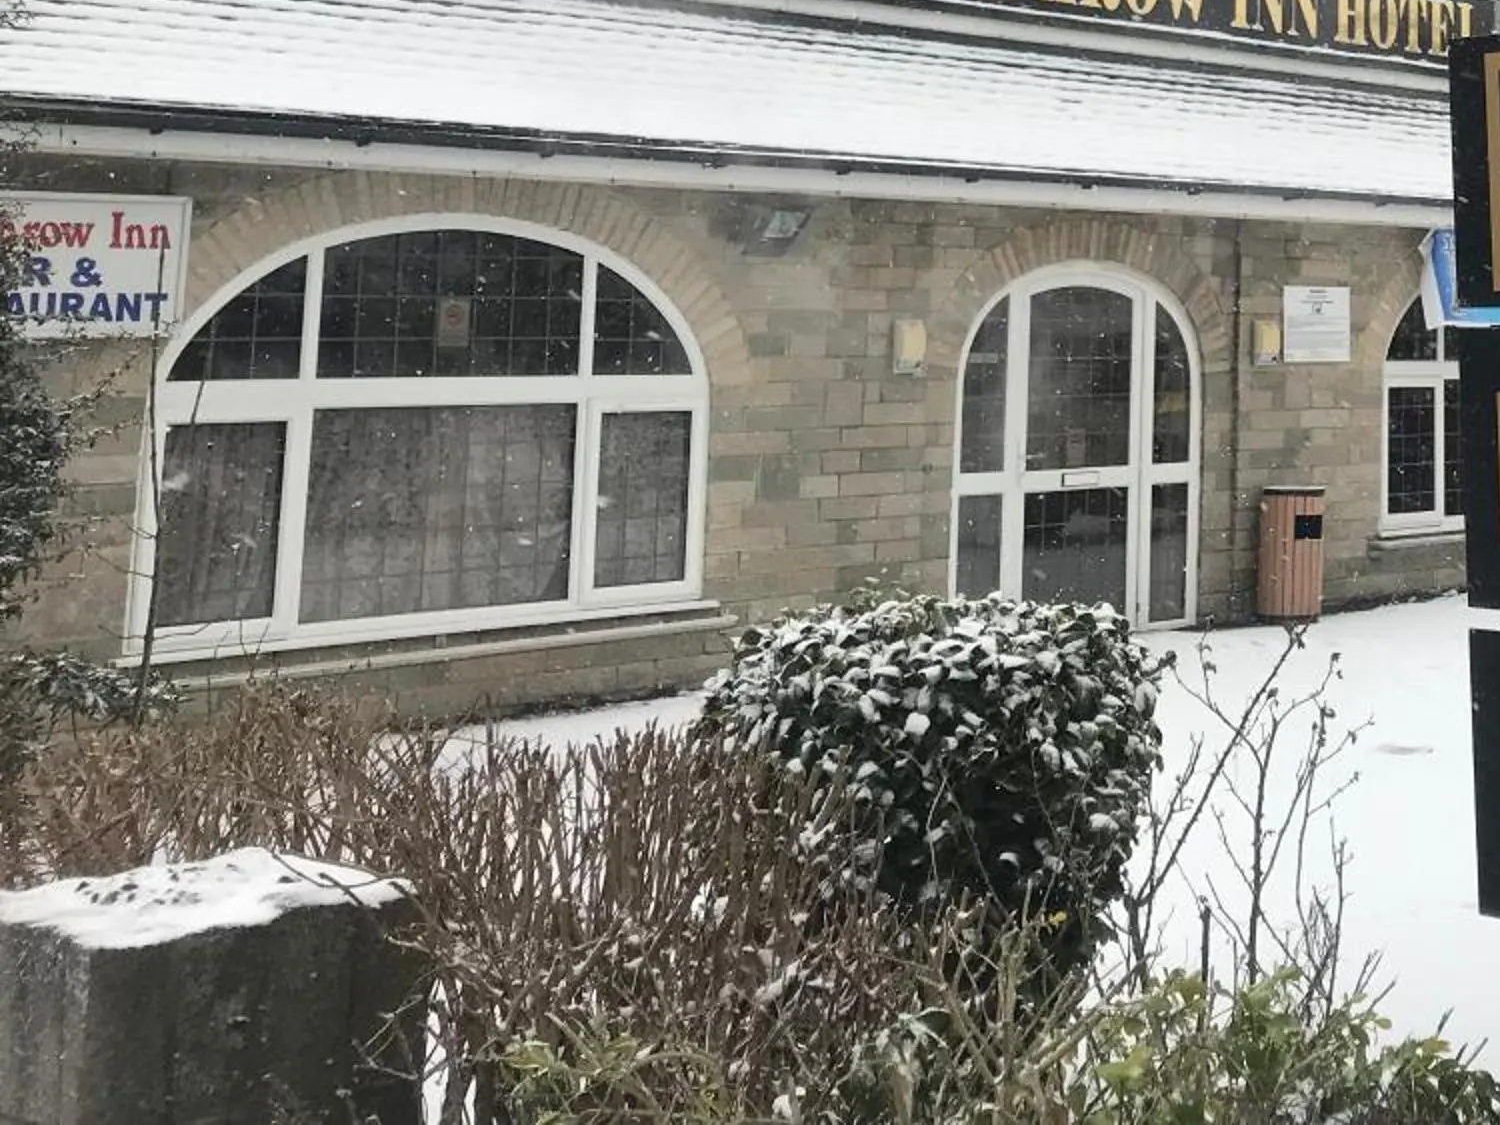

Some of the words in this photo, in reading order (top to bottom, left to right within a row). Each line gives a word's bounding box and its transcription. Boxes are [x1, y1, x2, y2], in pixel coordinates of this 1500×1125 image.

[109, 211, 171, 249] Inn
[70, 257, 102, 287] &
[6, 292, 168, 322] AURANT
